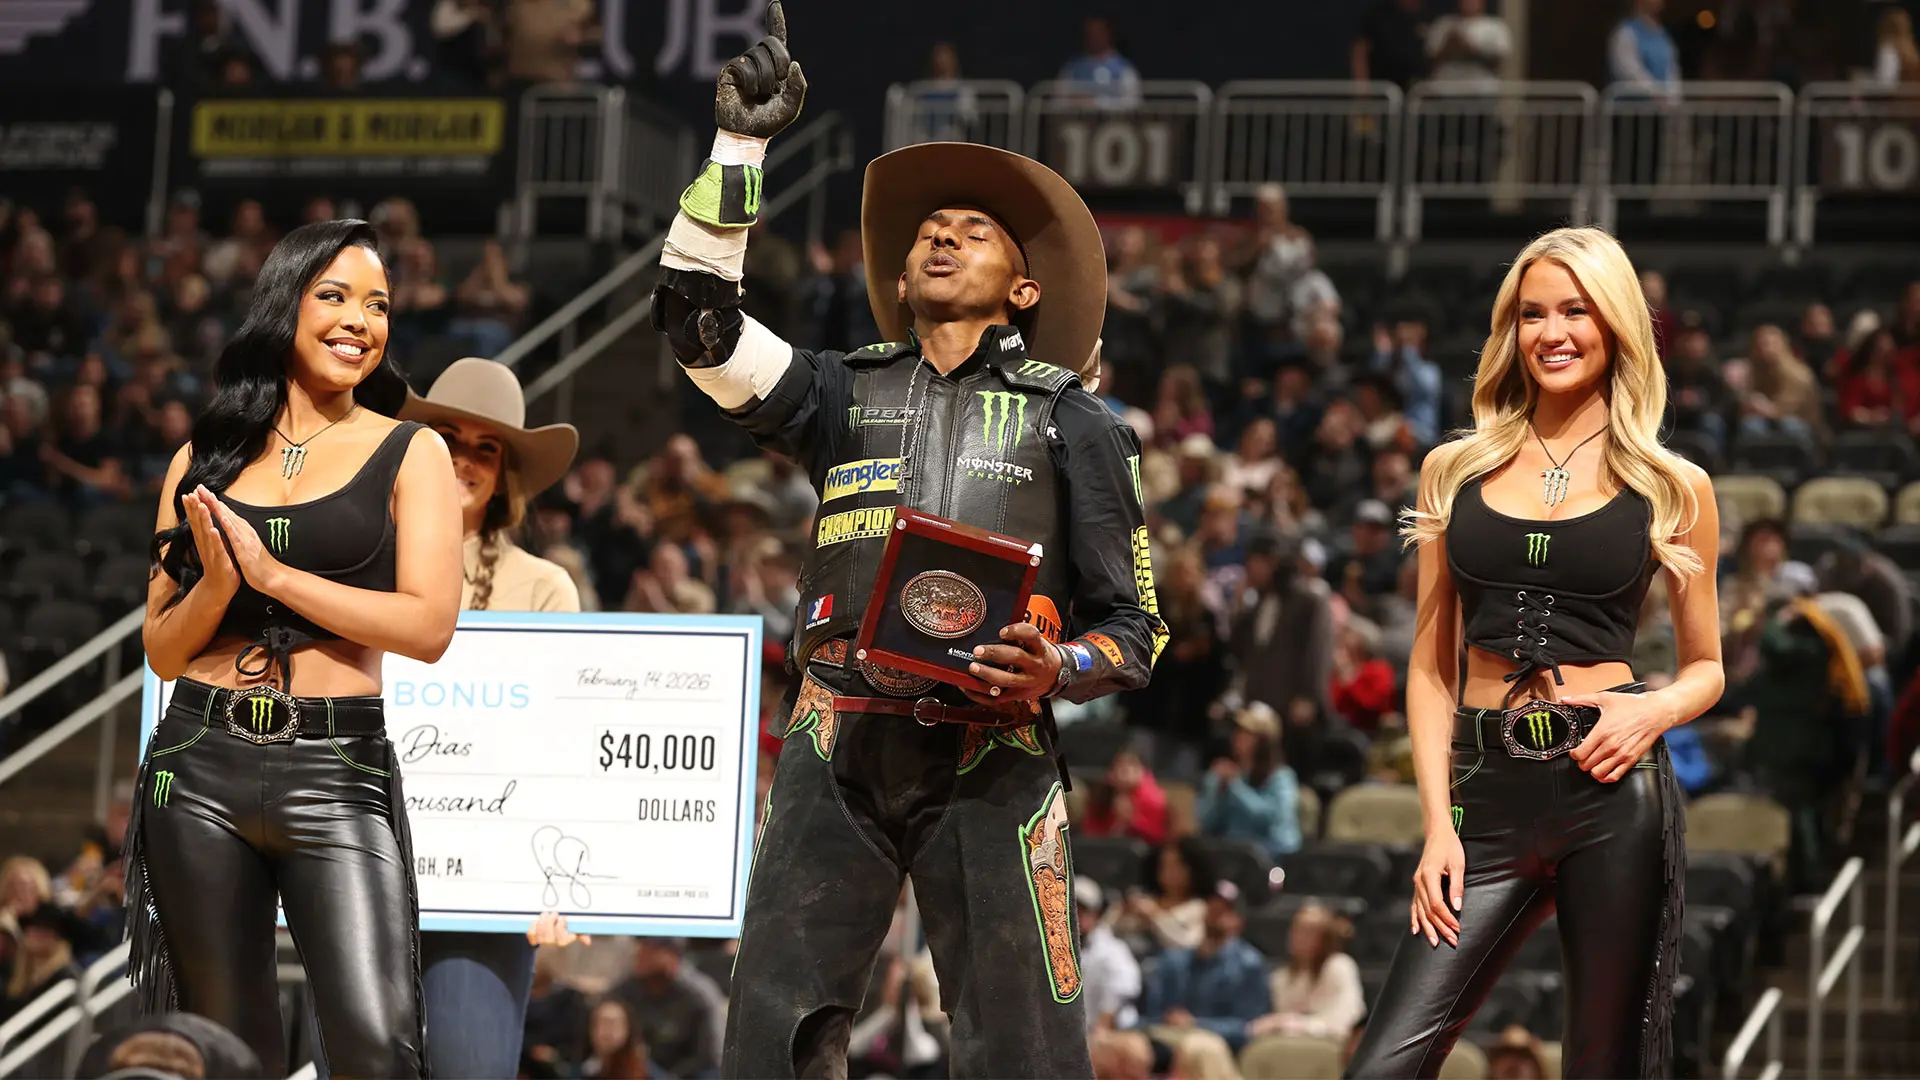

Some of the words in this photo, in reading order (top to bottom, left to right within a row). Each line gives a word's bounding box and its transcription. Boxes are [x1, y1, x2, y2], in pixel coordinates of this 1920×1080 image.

[1062, 122, 1174, 184] 101
[827, 460, 900, 490] Wrangler
[967, 470, 1022, 486] ENERGY
[818, 508, 897, 541] CHAMPION
[394, 681, 530, 709] BONUS
[577, 667, 638, 700] February
[664, 671, 711, 690] 2026
[402, 724, 473, 763] Dias
[599, 729, 716, 775] $40,000
[402, 779, 518, 814] ousand
[638, 798, 716, 823] DOLLARS
[413, 856, 441, 878] GH,
[446, 857, 464, 876] PA
